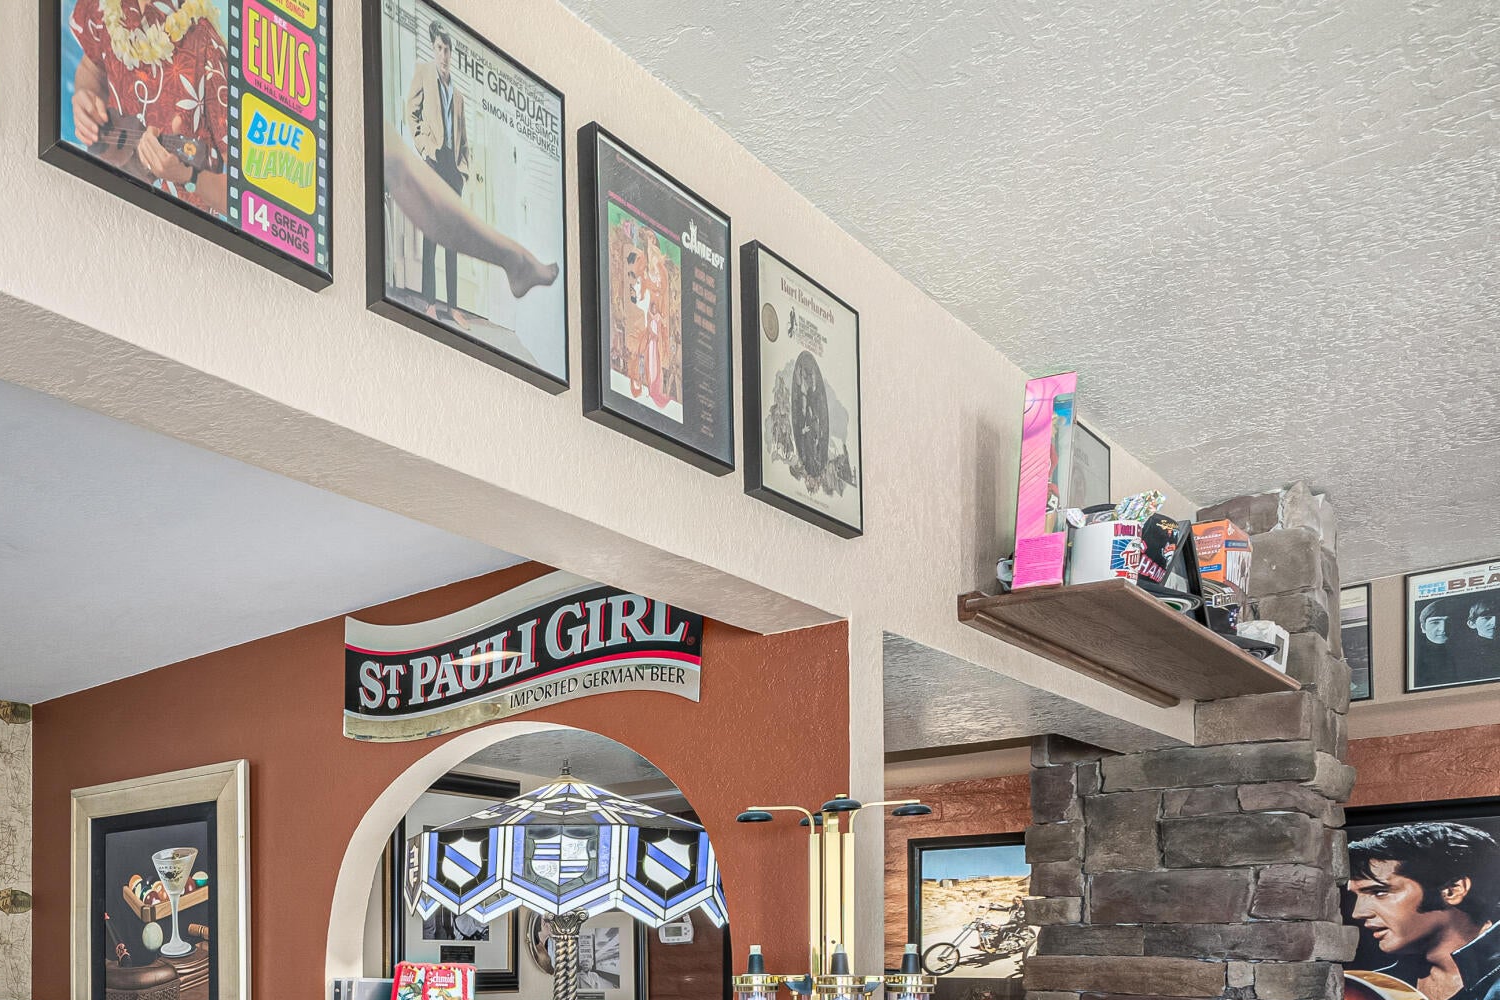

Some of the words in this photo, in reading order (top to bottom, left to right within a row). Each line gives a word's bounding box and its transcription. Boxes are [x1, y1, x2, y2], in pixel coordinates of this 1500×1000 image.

[248, 8, 311, 107] ELVIS
[455, 47, 485, 85] THE
[487, 70, 559, 135] GRADUATE
[246, 110, 304, 152] BLUE
[482, 97, 508, 124] SIMON
[509, 119, 515, 129] &
[516, 121, 561, 160] GARFUNKEL
[516, 110, 533, 129] PAUL
[535, 122, 559, 146] SIMON
[248, 196, 270, 234] 14
[273, 212, 310, 239] GREAT
[271, 226, 310, 255] SONGS
[682, 219, 725, 271] CAMELOT
[408, 617, 540, 707] PAULI
[545, 595, 688, 660] GIRL
[509, 678, 578, 710] IMPORTED
[582, 667, 646, 692] GERMAN
[650, 667, 686, 685] BEER
